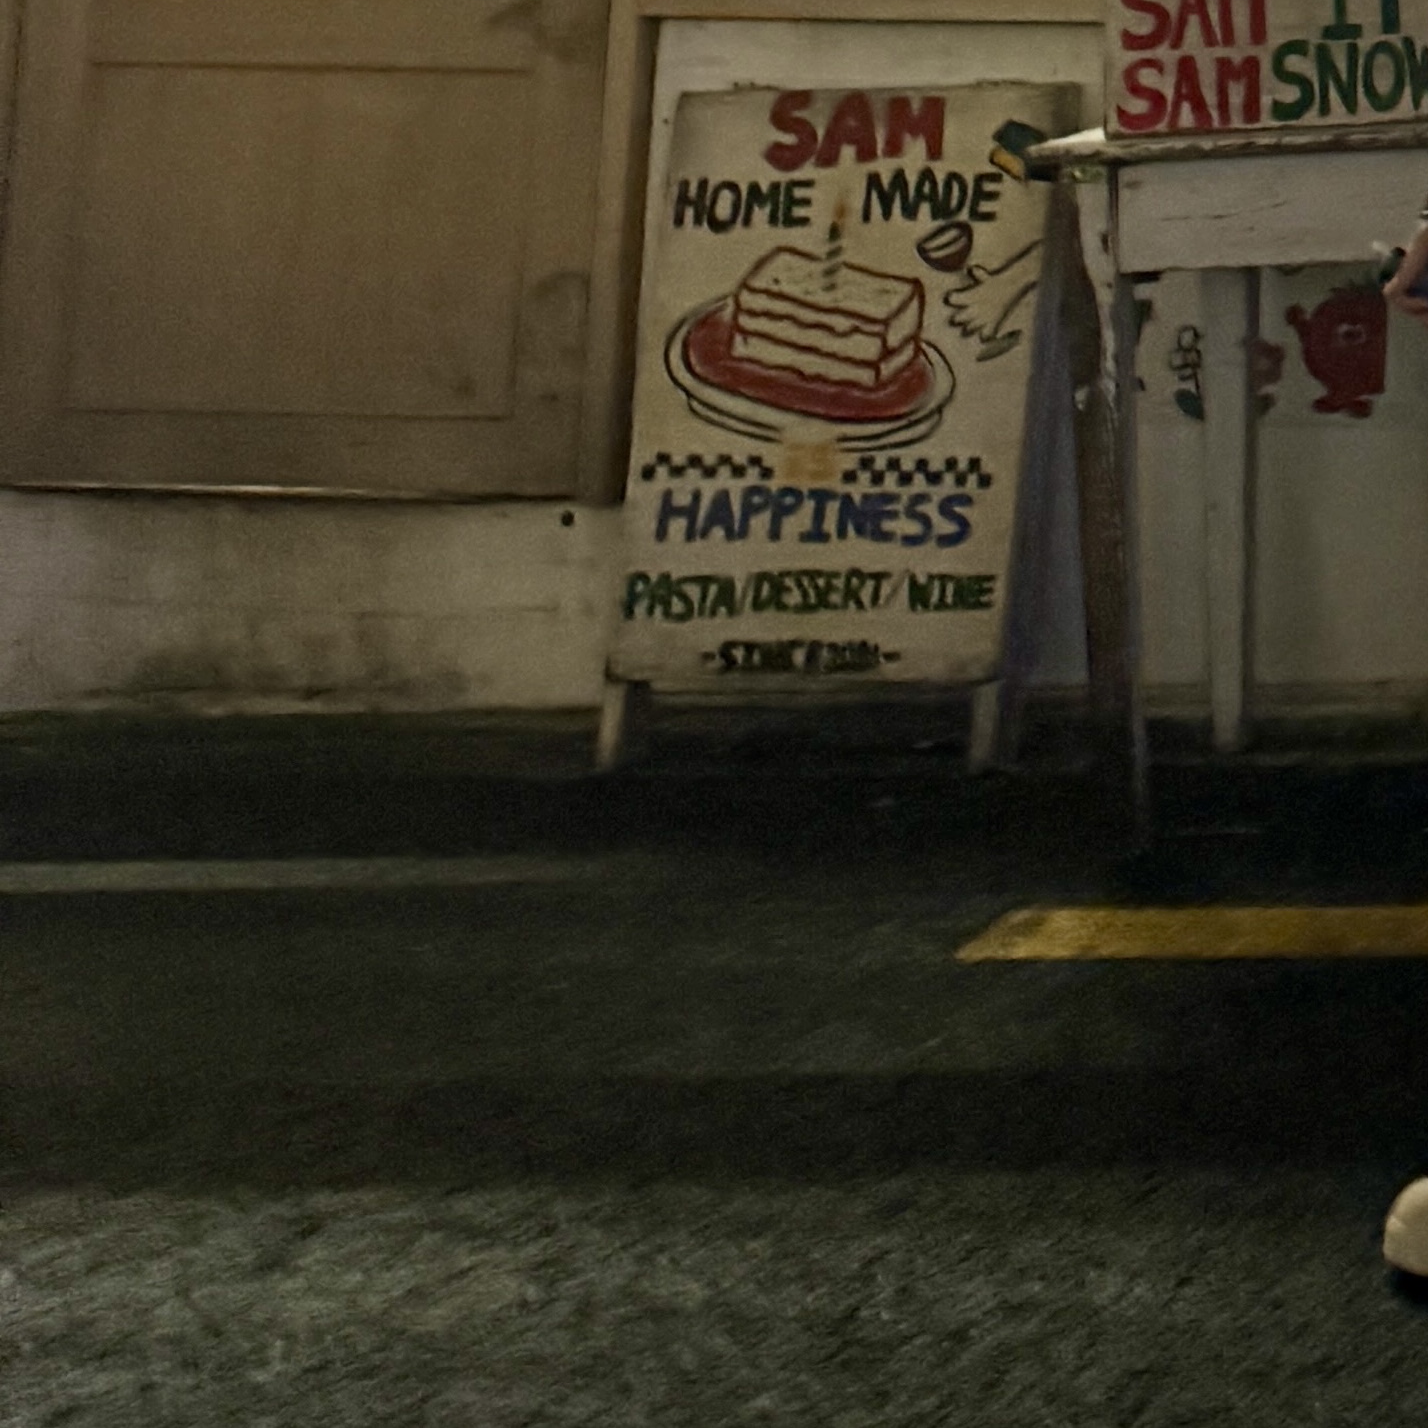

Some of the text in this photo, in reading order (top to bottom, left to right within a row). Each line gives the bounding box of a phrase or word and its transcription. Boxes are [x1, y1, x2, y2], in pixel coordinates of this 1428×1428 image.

[1116, 55, 1261, 132] SAM
[764, 90, 946, 172] SAM
[674, 166, 1002, 232] HOME MADE
[656, 487, 975, 548] HAPPINESS
